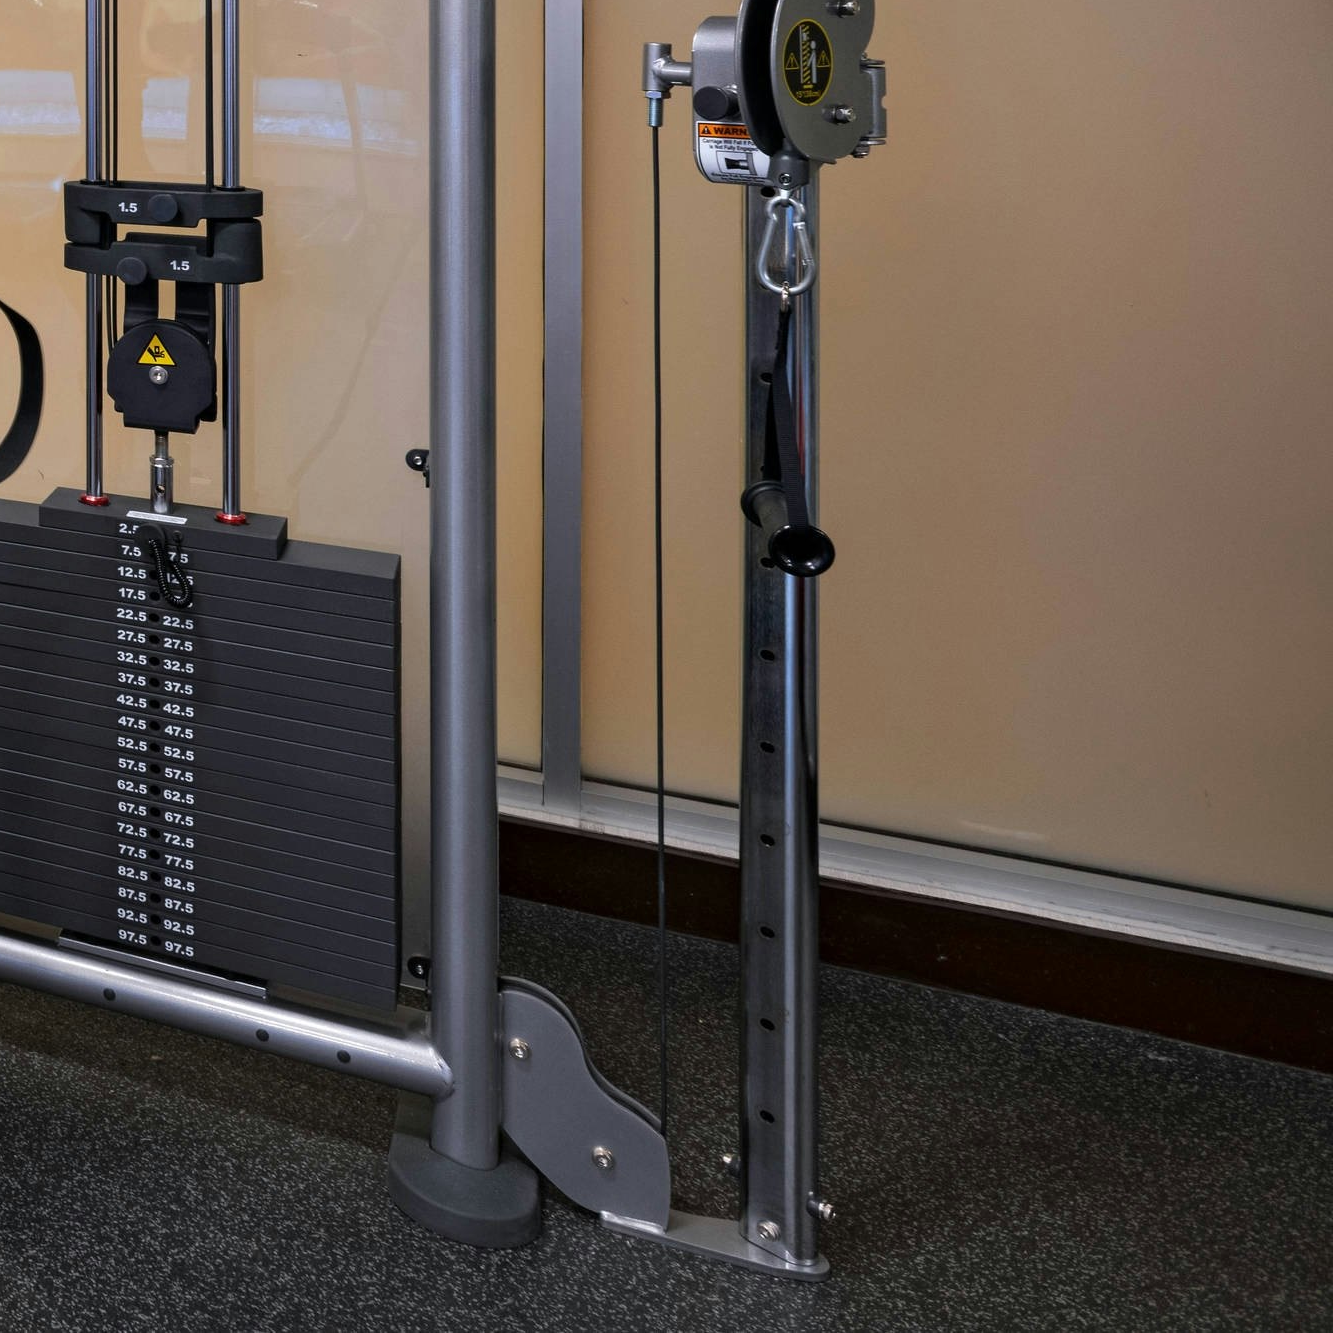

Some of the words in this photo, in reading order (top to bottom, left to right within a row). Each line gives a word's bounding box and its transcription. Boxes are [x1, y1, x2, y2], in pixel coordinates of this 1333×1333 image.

[713, 127, 748, 136] WARN
[118, 202, 138, 213] 1.5
[169, 259, 190, 271] 1.5
[121, 544, 142, 557] 7.5
[168, 551, 189, 564] 75
[117, 566, 147, 580] 12.5
[118, 587, 146, 601] 17.5
[116, 607, 147, 622] 22.5
[162, 615, 194, 630] 22.5
[117, 629, 146, 644] 27.5
[163, 637, 193, 652] 27.5
[116, 650, 148, 666] 32.5
[163, 659, 194, 674] 32.5
[117, 672, 147, 687] 37.5
[164, 680, 193, 695] 37.5
[116, 694, 147, 709] 42.5
[162, 702, 195, 718] 42.5
[117, 715, 147, 730] 47.5
[164, 725, 194, 740] 47.5
[117, 736, 148, 752] 52.5
[163, 745, 195, 761] 52.5
[118, 757, 147, 773] 57.5
[164, 767, 194, 783] 57.5
[116, 779, 148, 795] 62.5
[163, 789, 195, 805] 62.5
[118, 801, 147, 817] 67.5
[164, 811, 194, 827] 67.5
[116, 822, 148, 838] 72.5
[163, 832, 195, 849] 72.5
[118, 843, 147, 859] 77.5
[164, 854, 194, 870] 77.5
[117, 865, 148, 881] 82.5
[164, 876, 195, 893] 82.5
[118, 887, 147, 903] 87.5
[164, 898, 194, 914] 87.5
[117, 907, 148, 924] 92.5
[163, 919, 195, 936] 92.5
[118, 929, 147, 945] 97.5
[164, 940, 194, 957] 97.5
